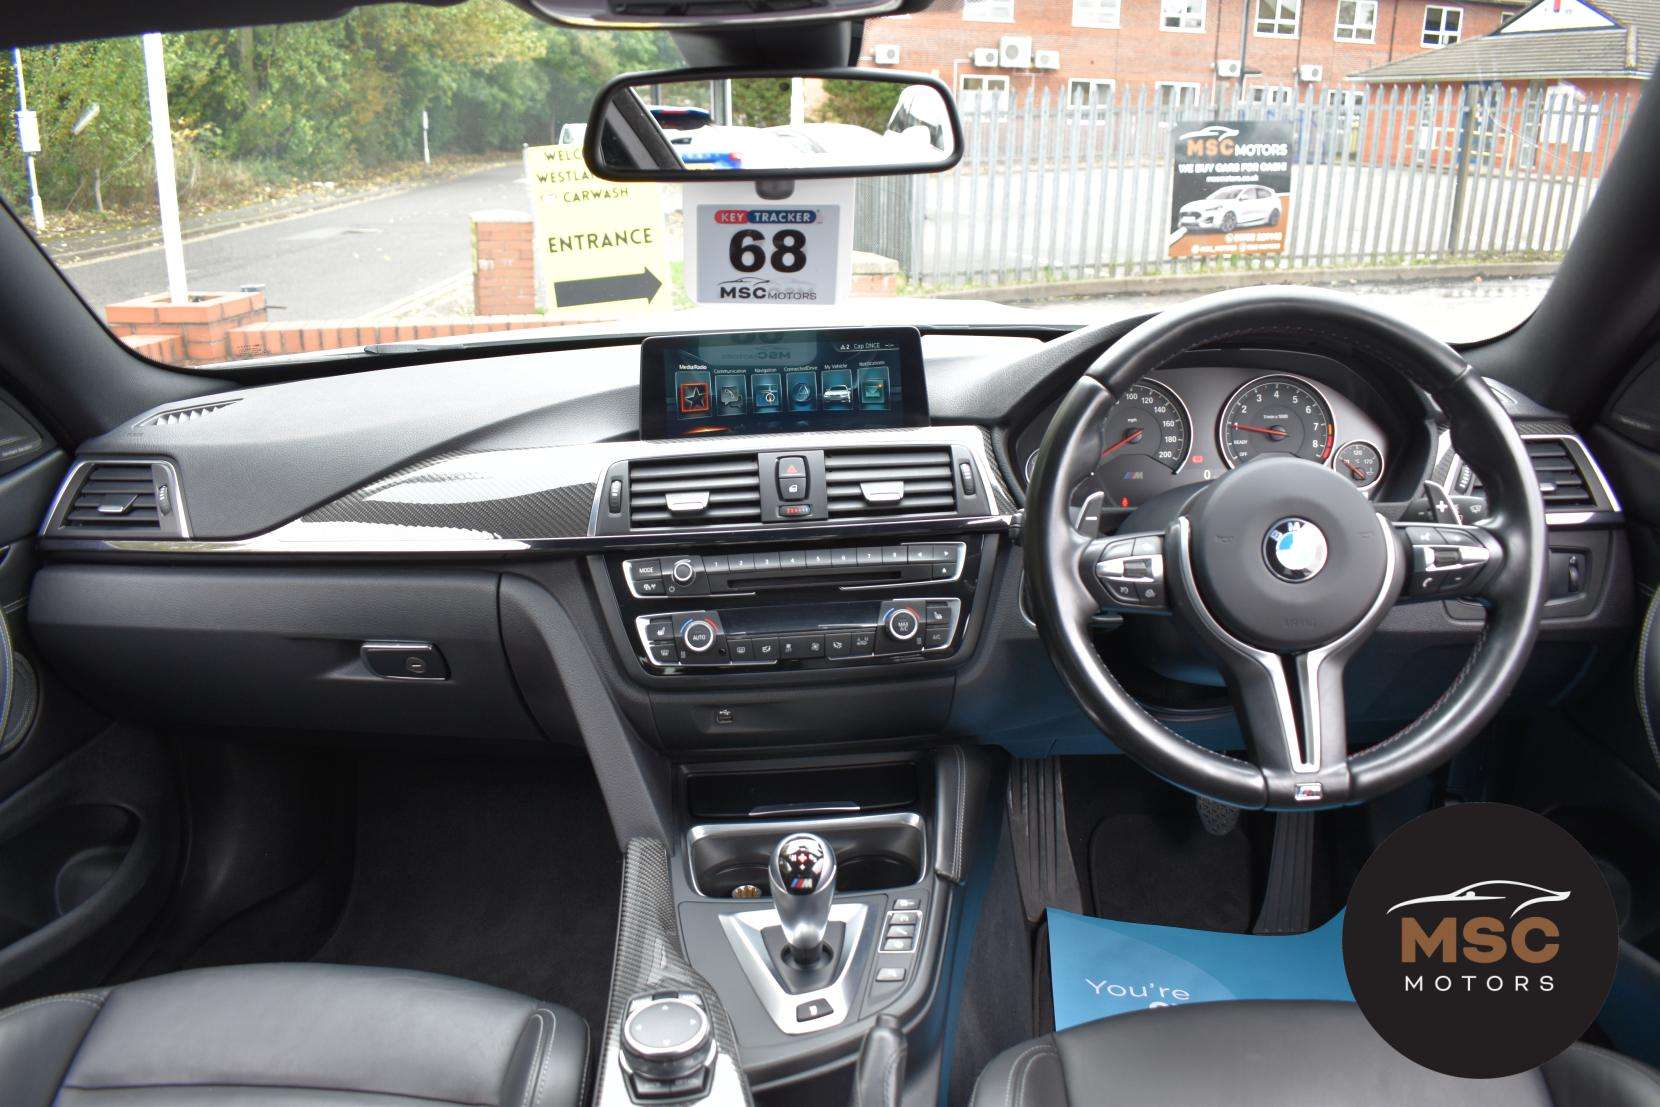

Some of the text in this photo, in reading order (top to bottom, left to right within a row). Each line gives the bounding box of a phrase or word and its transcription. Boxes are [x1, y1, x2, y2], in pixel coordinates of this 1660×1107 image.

[1187, 138, 1288, 156] MSC MOTORS
[544, 149, 583, 161] WELC
[563, 187, 628, 202] CARWASH
[720, 212, 811, 223] KEY TRACKER
[548, 227, 653, 253] ENTRANCE
[729, 228, 807, 273] 68
[720, 286, 817, 301] MSC MOTORS
[1256, 394, 1262, 402] 3
[1273, 390, 1280, 398] 4
[1292, 395, 1298, 403] 5
[1241, 405, 1247, 413] 2
[1305, 406, 1312, 414] 6
[1313, 422, 1319, 431] 7
[1312, 439, 1319, 447] 8
[1085, 977, 1192, 1000] You're
